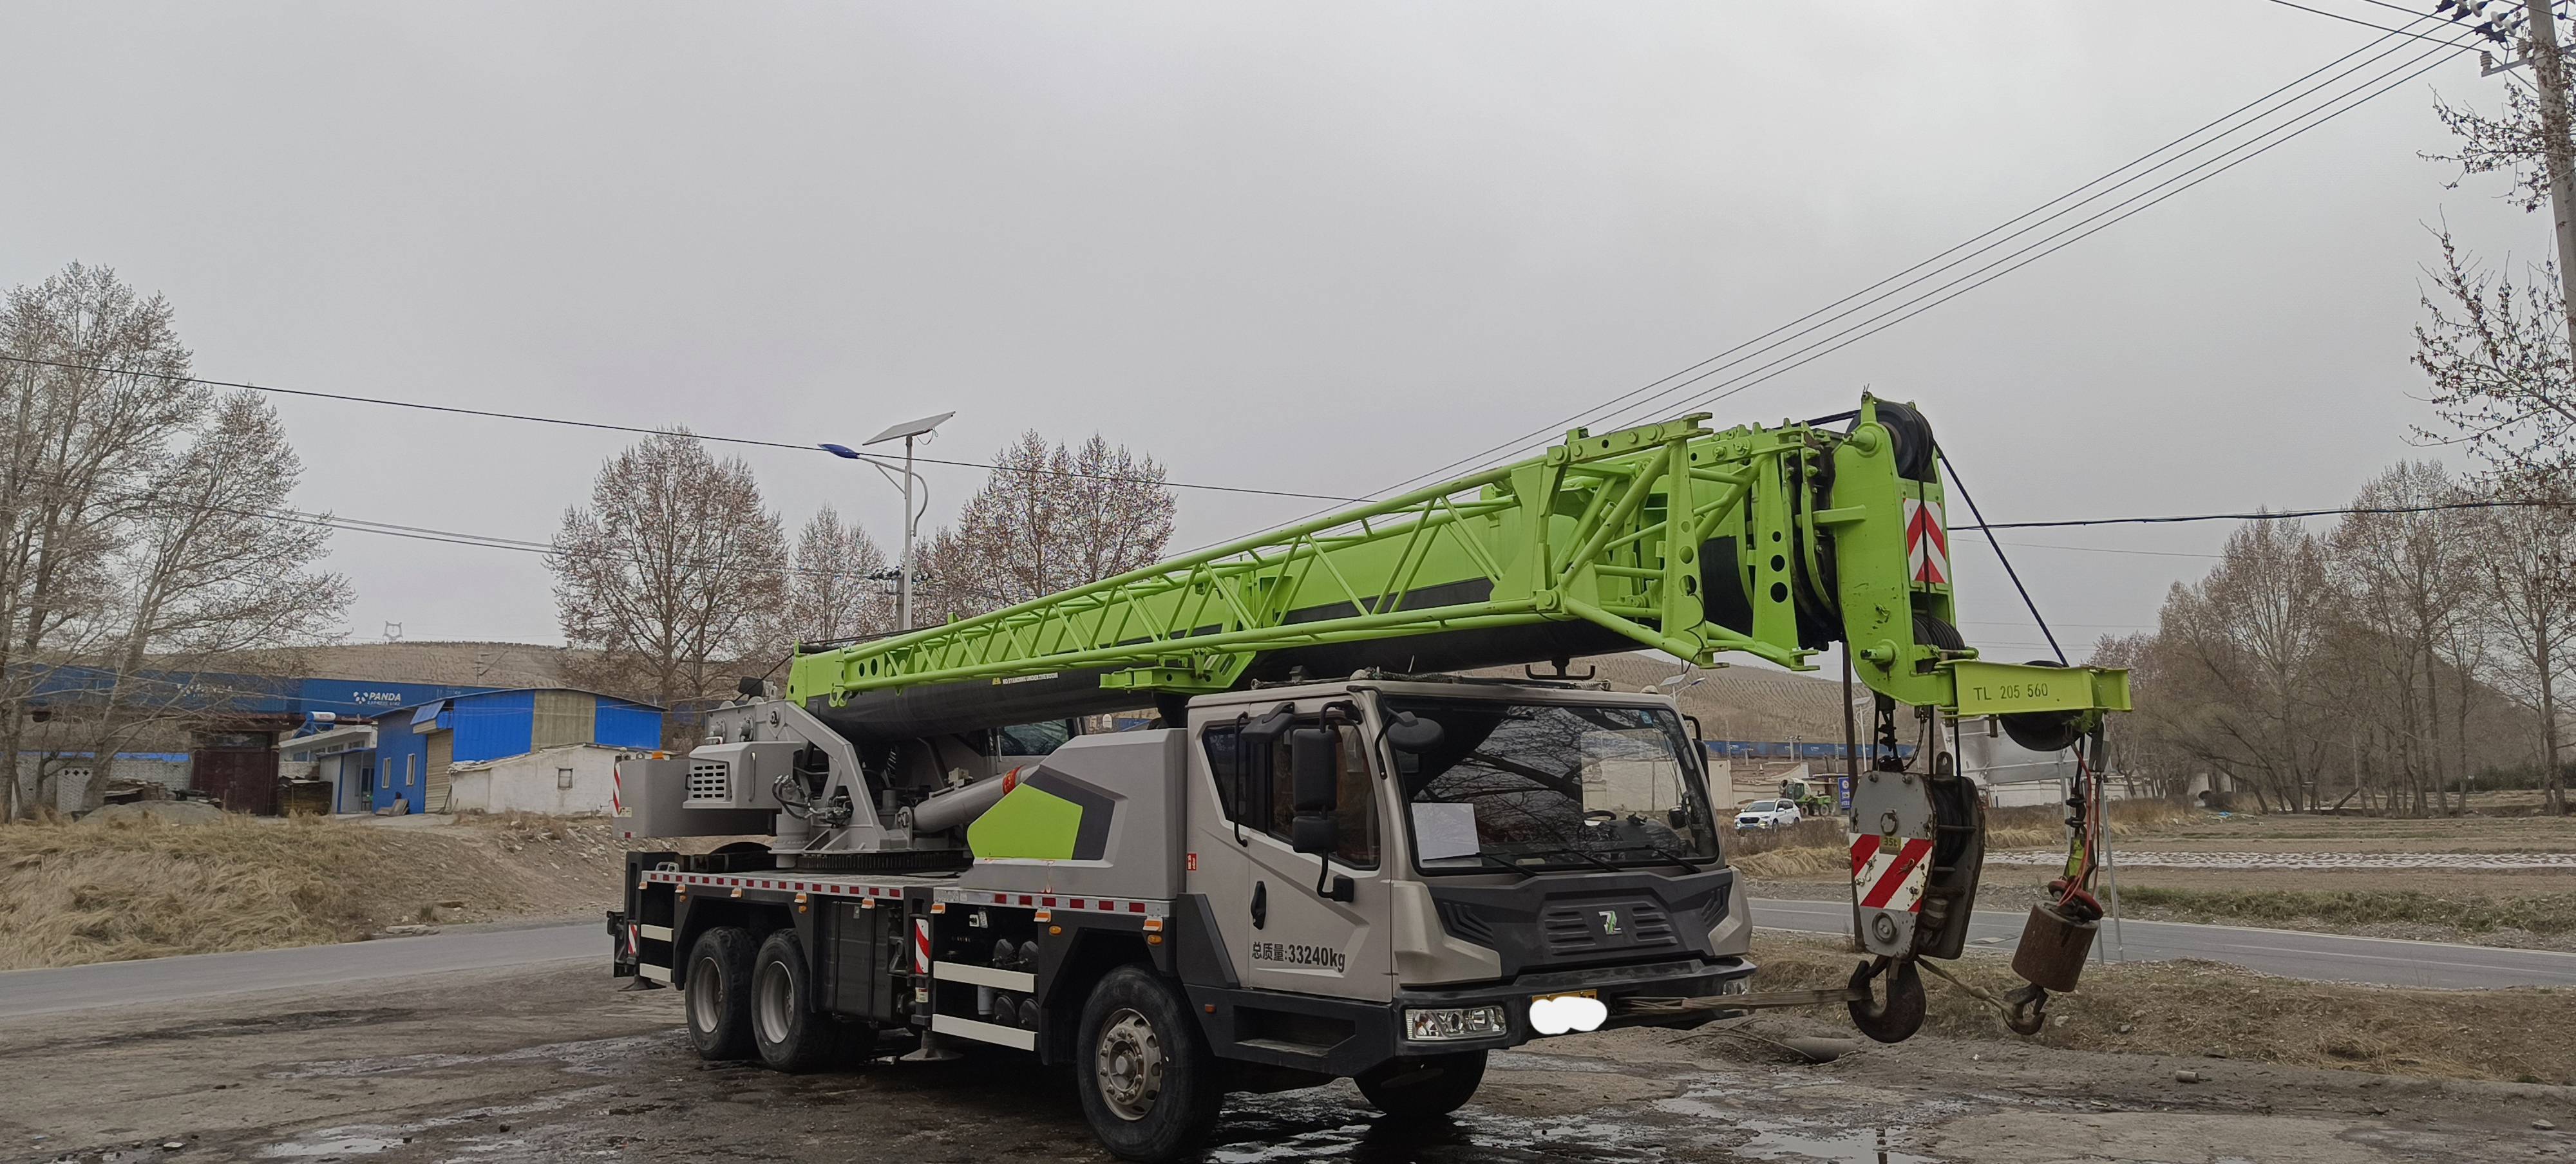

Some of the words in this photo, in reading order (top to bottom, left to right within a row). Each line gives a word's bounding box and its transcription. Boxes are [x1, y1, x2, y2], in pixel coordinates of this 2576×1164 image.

[369, 691, 401, 702] PANDA
[1973, 686, 1992, 700] TL
[2000, 684, 2020, 699] 205
[2027, 682, 2048, 697] 560
[1252, 941, 1345, 973] 总质量:33240kg
